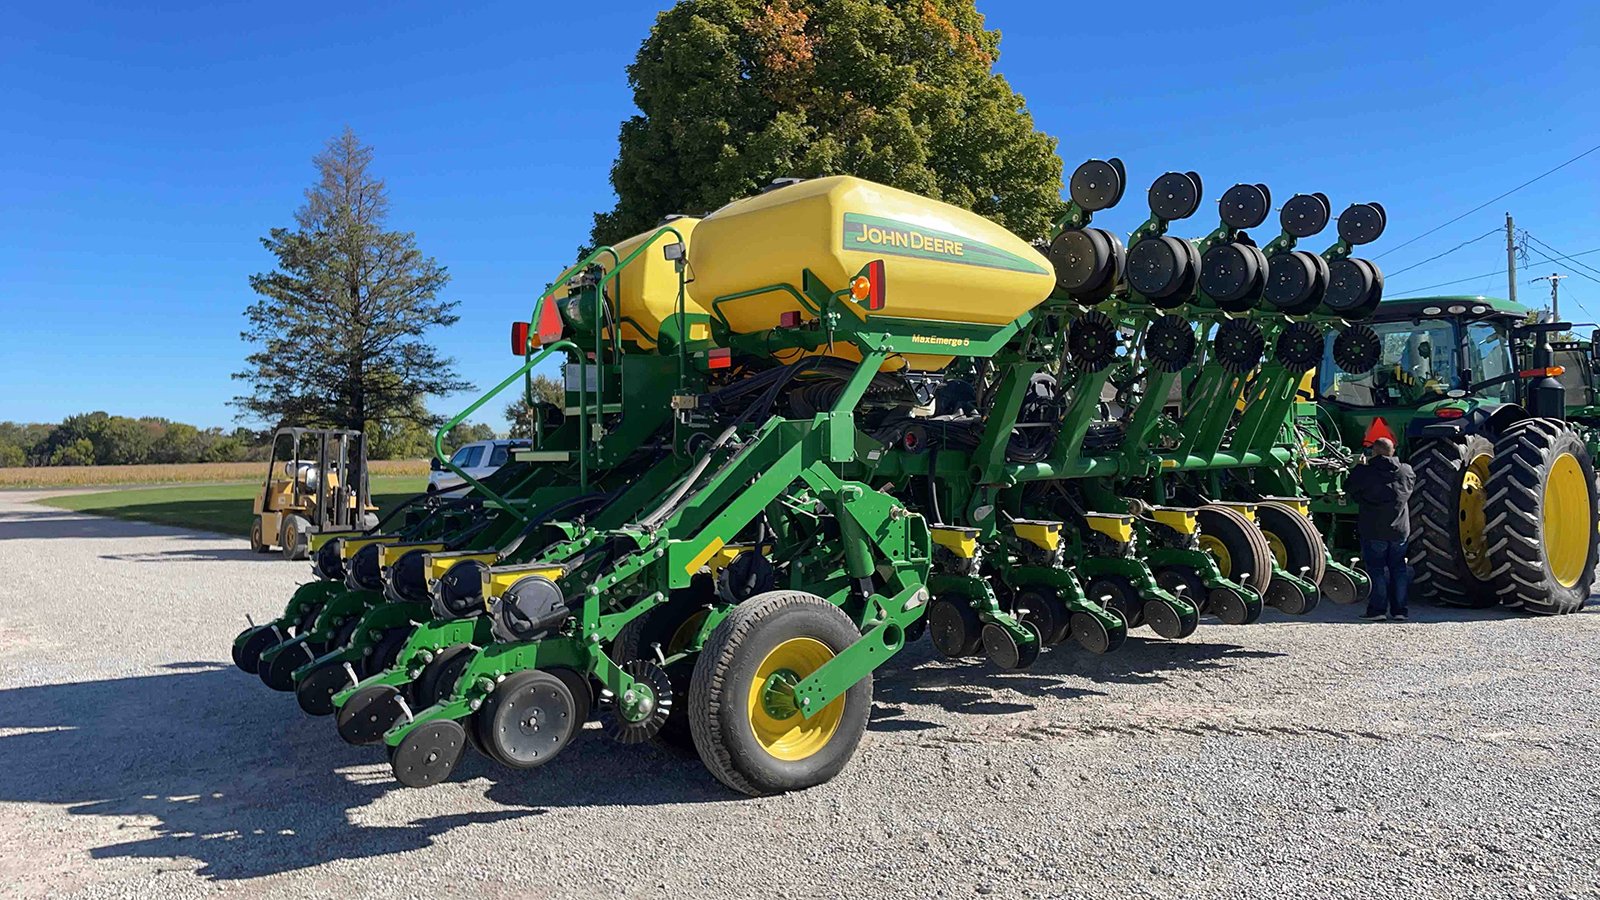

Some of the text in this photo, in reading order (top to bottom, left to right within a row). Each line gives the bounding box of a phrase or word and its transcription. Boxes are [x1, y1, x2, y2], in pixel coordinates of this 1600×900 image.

[857, 224, 964, 256] JOHN DEERE
[912, 334, 970, 348] MaxEmerge 5
